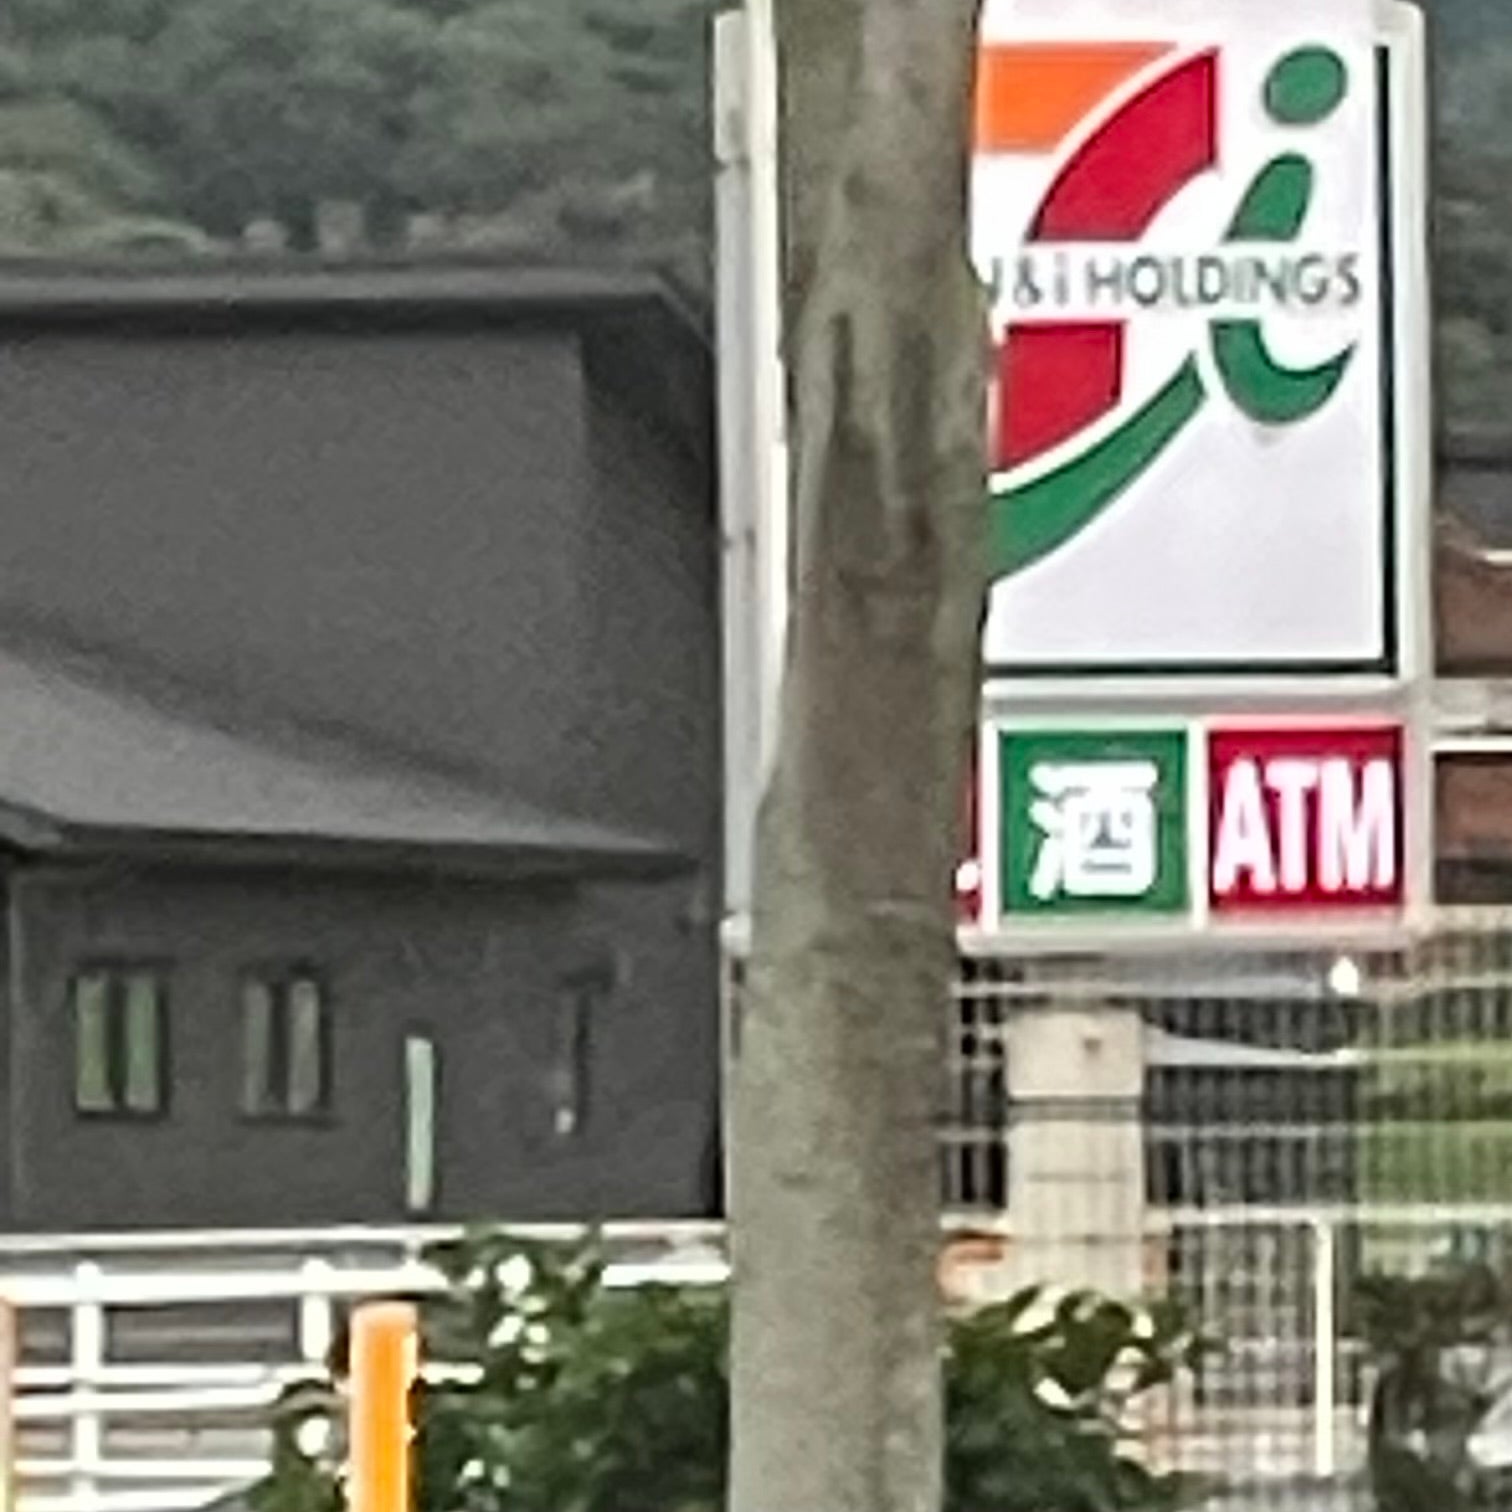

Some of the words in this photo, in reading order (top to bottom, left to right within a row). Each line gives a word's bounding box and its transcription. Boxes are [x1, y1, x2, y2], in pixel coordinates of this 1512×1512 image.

[1085, 253, 1361, 307] HOLDINGS
[1028, 761, 1160, 899] 酒
[1212, 758, 1397, 894] ATM
